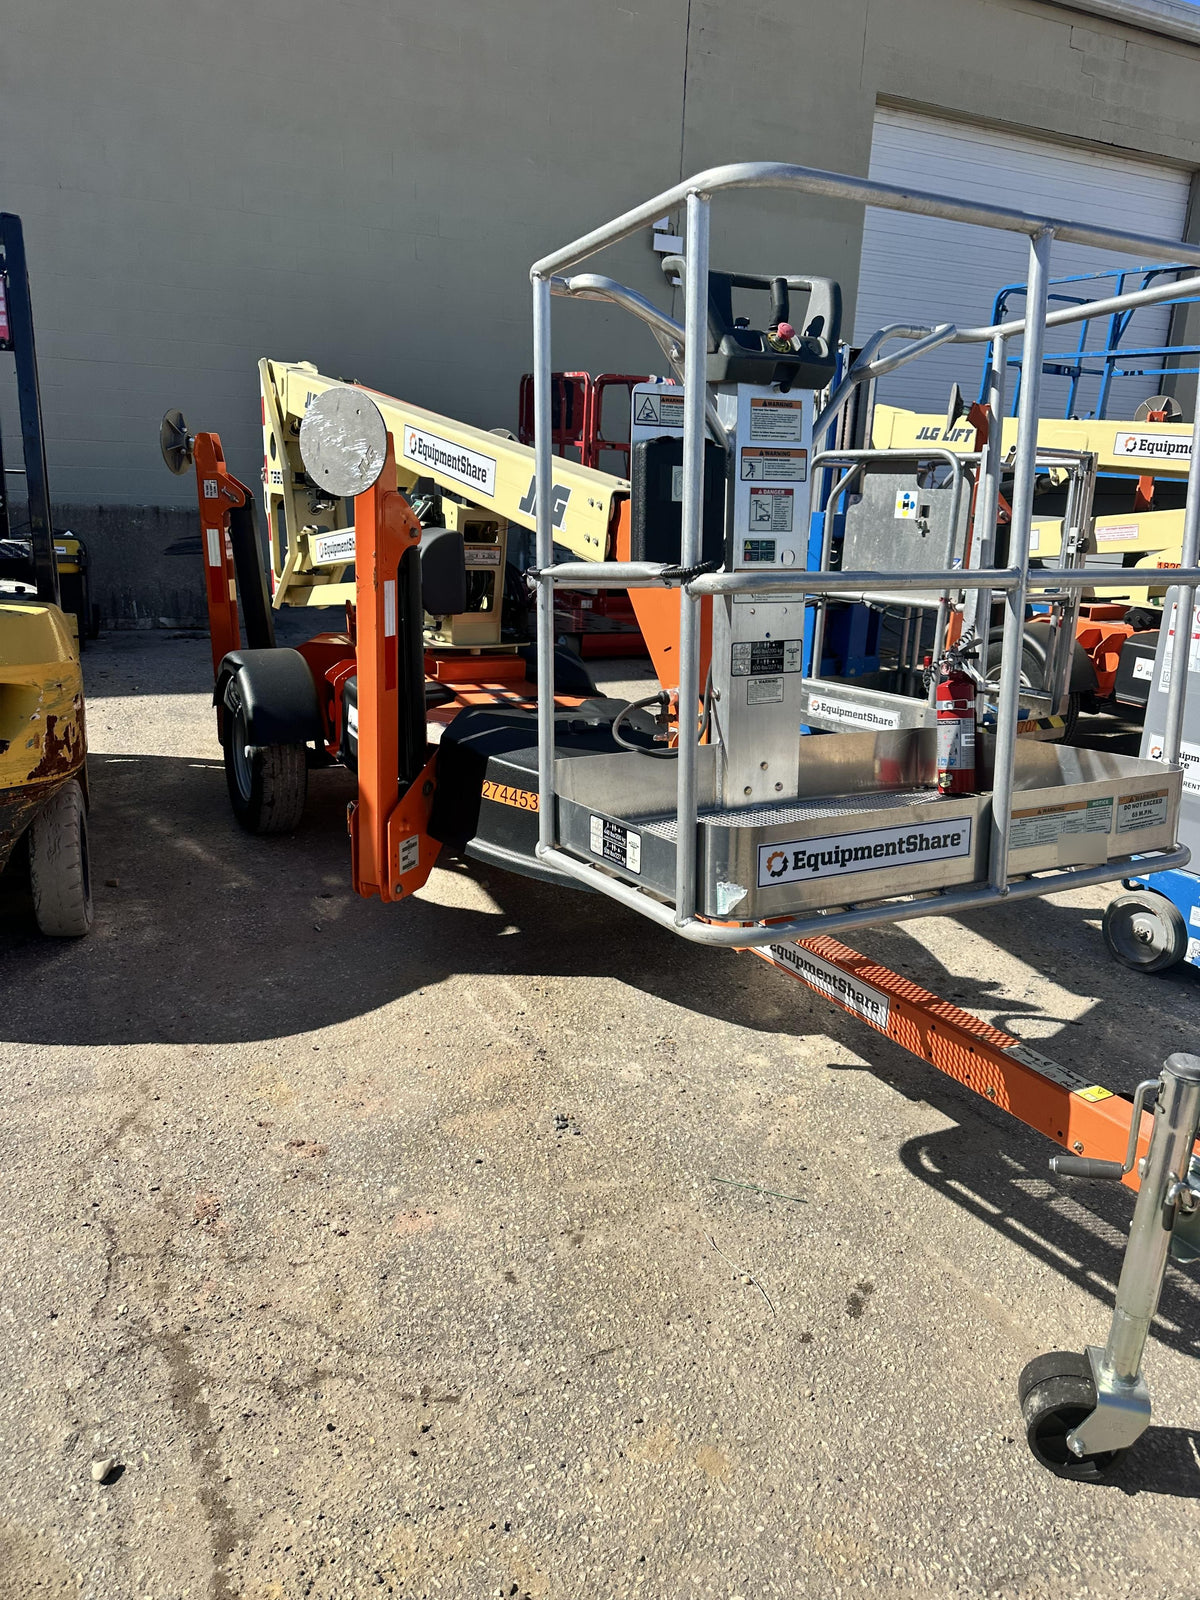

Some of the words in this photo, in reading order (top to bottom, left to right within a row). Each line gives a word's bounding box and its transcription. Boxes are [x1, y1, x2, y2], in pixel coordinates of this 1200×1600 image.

[916, 427, 941, 440] JLG
[942, 428, 974, 442] LIFT
[418, 438, 487, 484] EquipmentShare
[518, 474, 572, 529] JG
[821, 703, 894, 727] EquipmentShare
[482, 780, 539, 810] 274453
[1143, 798, 1163, 807] EXCEED
[792, 832, 961, 872] EquipmentShare
